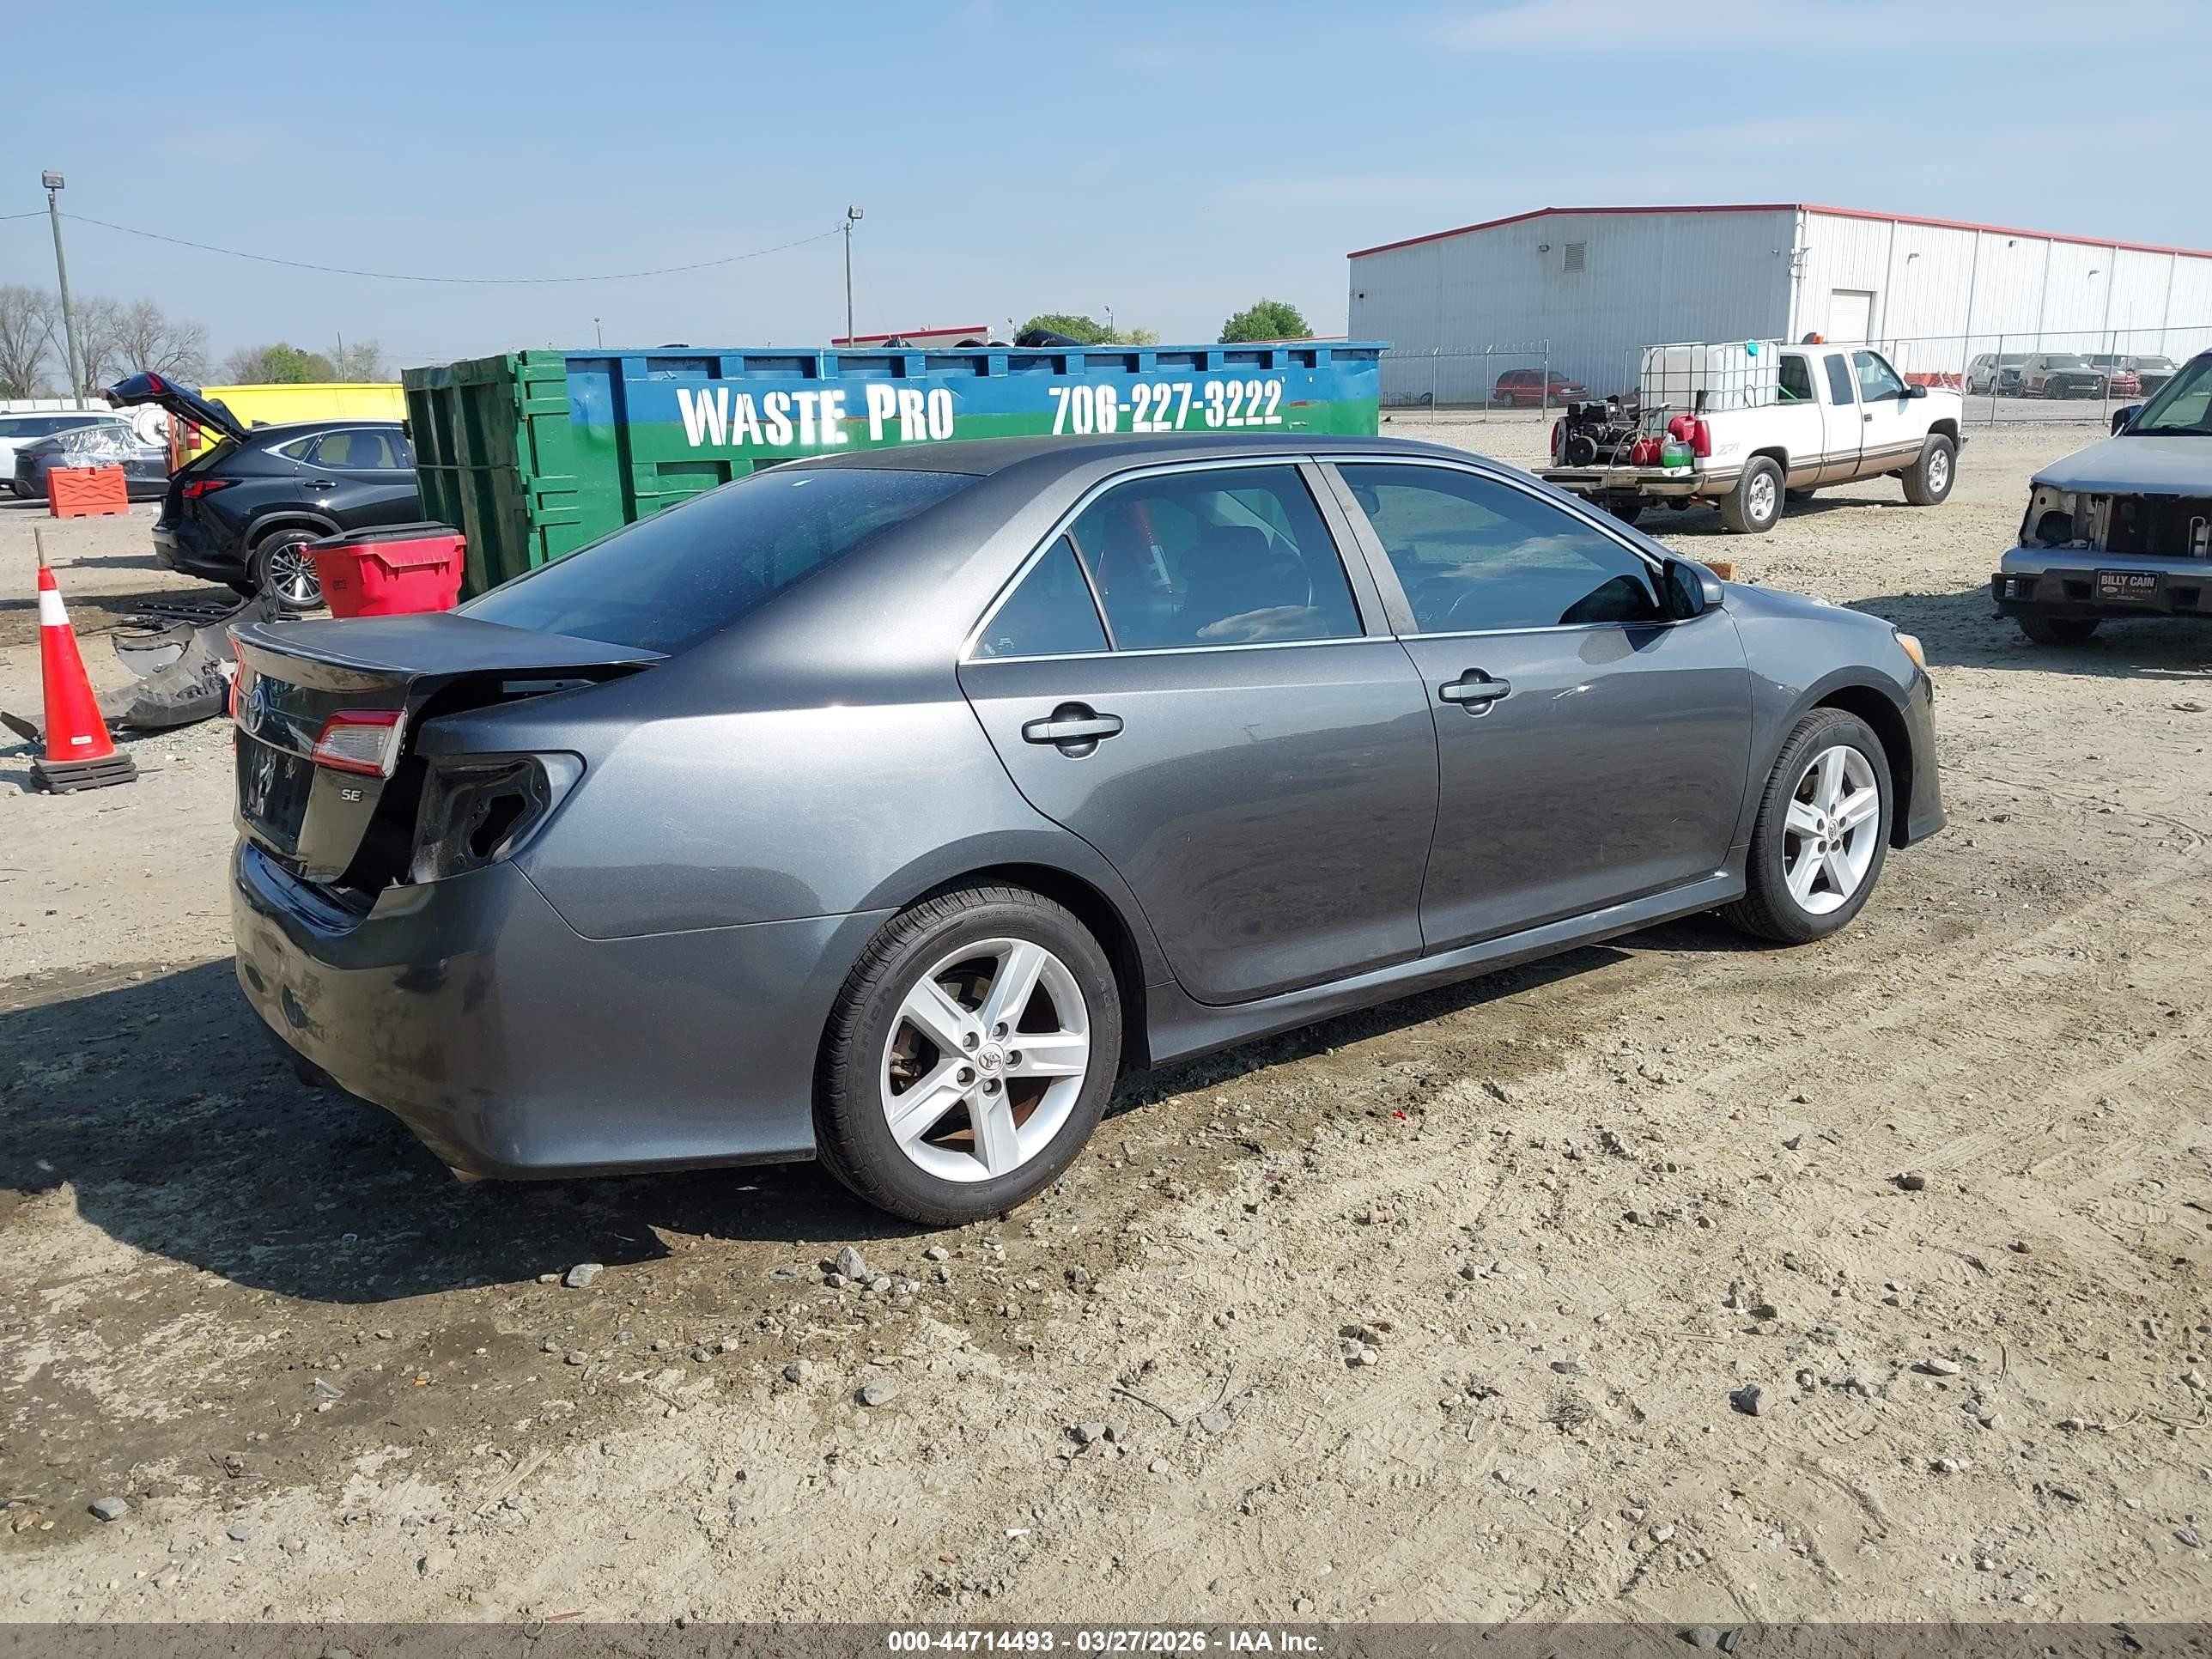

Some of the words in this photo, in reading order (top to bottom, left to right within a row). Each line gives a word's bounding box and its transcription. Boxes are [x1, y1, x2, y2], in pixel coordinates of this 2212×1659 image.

[1048, 379, 1283, 435] 706-227-3222
[2101, 575, 2129, 586] BILLY
[2130, 576, 2154, 587] CAIN
[341, 788, 362, 802] SE
